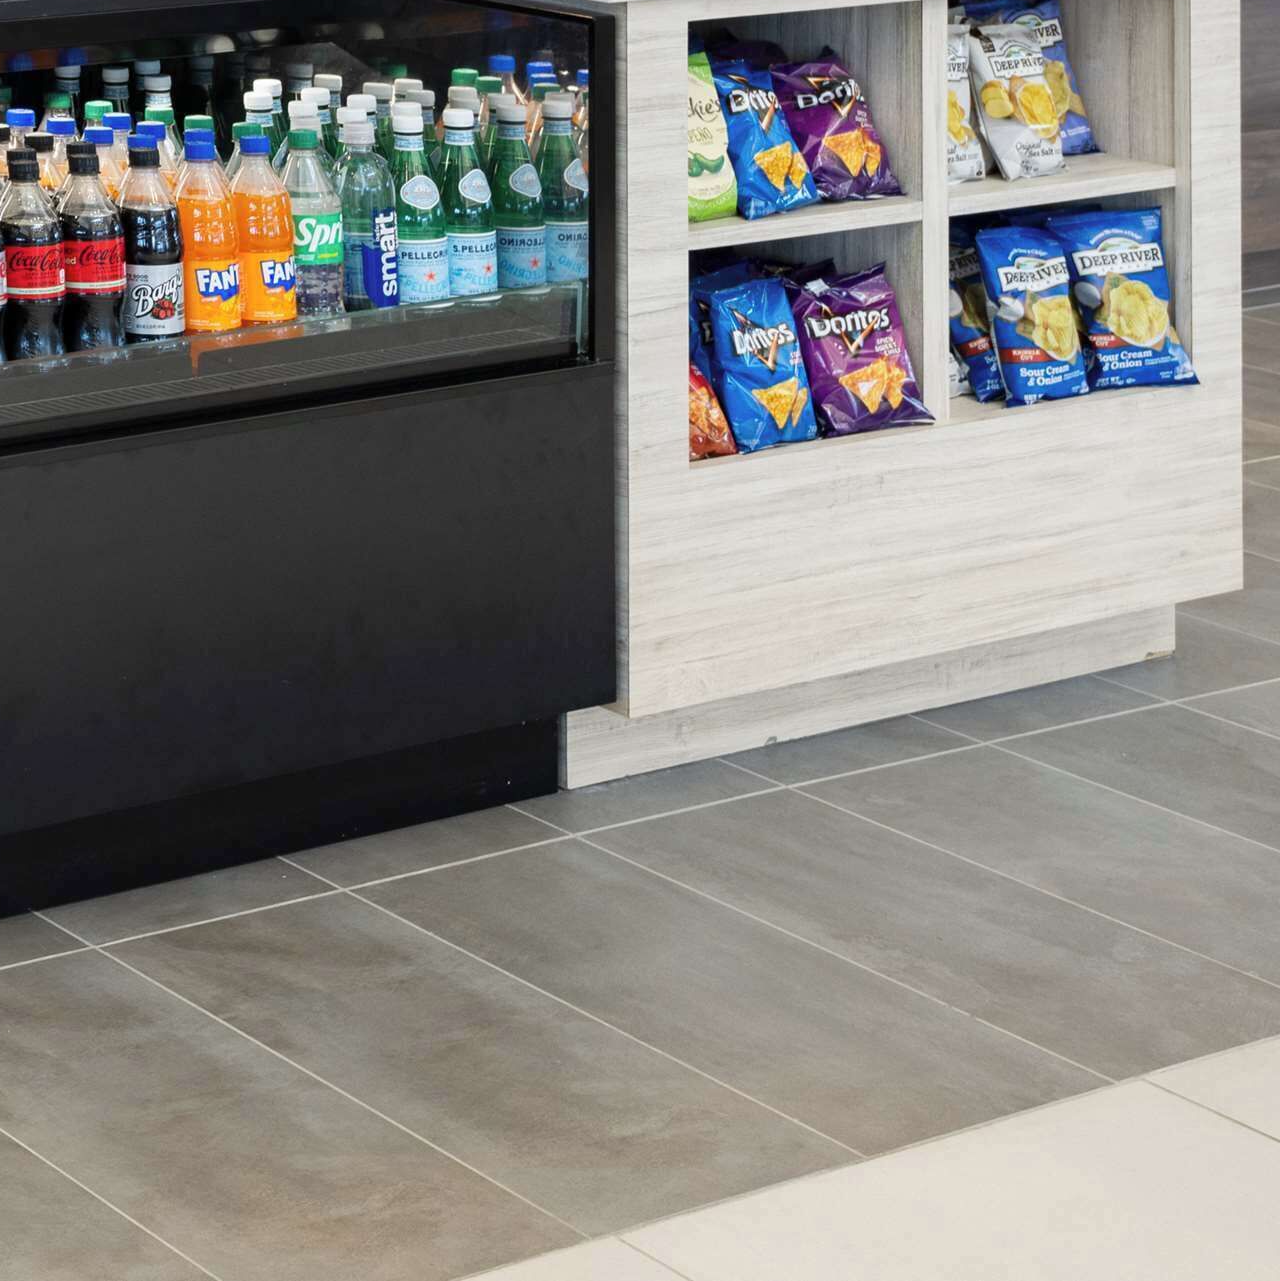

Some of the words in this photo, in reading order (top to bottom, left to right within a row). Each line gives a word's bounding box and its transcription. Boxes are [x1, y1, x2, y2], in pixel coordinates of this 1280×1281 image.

[994, 59, 1020, 72] DEEP
[375, 211, 398, 297] smart
[1079, 254, 1118, 270] DEEP
[1122, 246, 1161, 265] RIVER
[132, 267, 183, 318] Barq's
[807, 307, 890, 338] Doritos
[733, 322, 795, 355] Doritos
[1111, 359, 1143, 370] Onion
[1120, 349, 1153, 361] Cream
[1019, 367, 1045, 378] Sour
[1046, 364, 1070, 374] Cream
[1038, 374, 1063, 386] Onion
